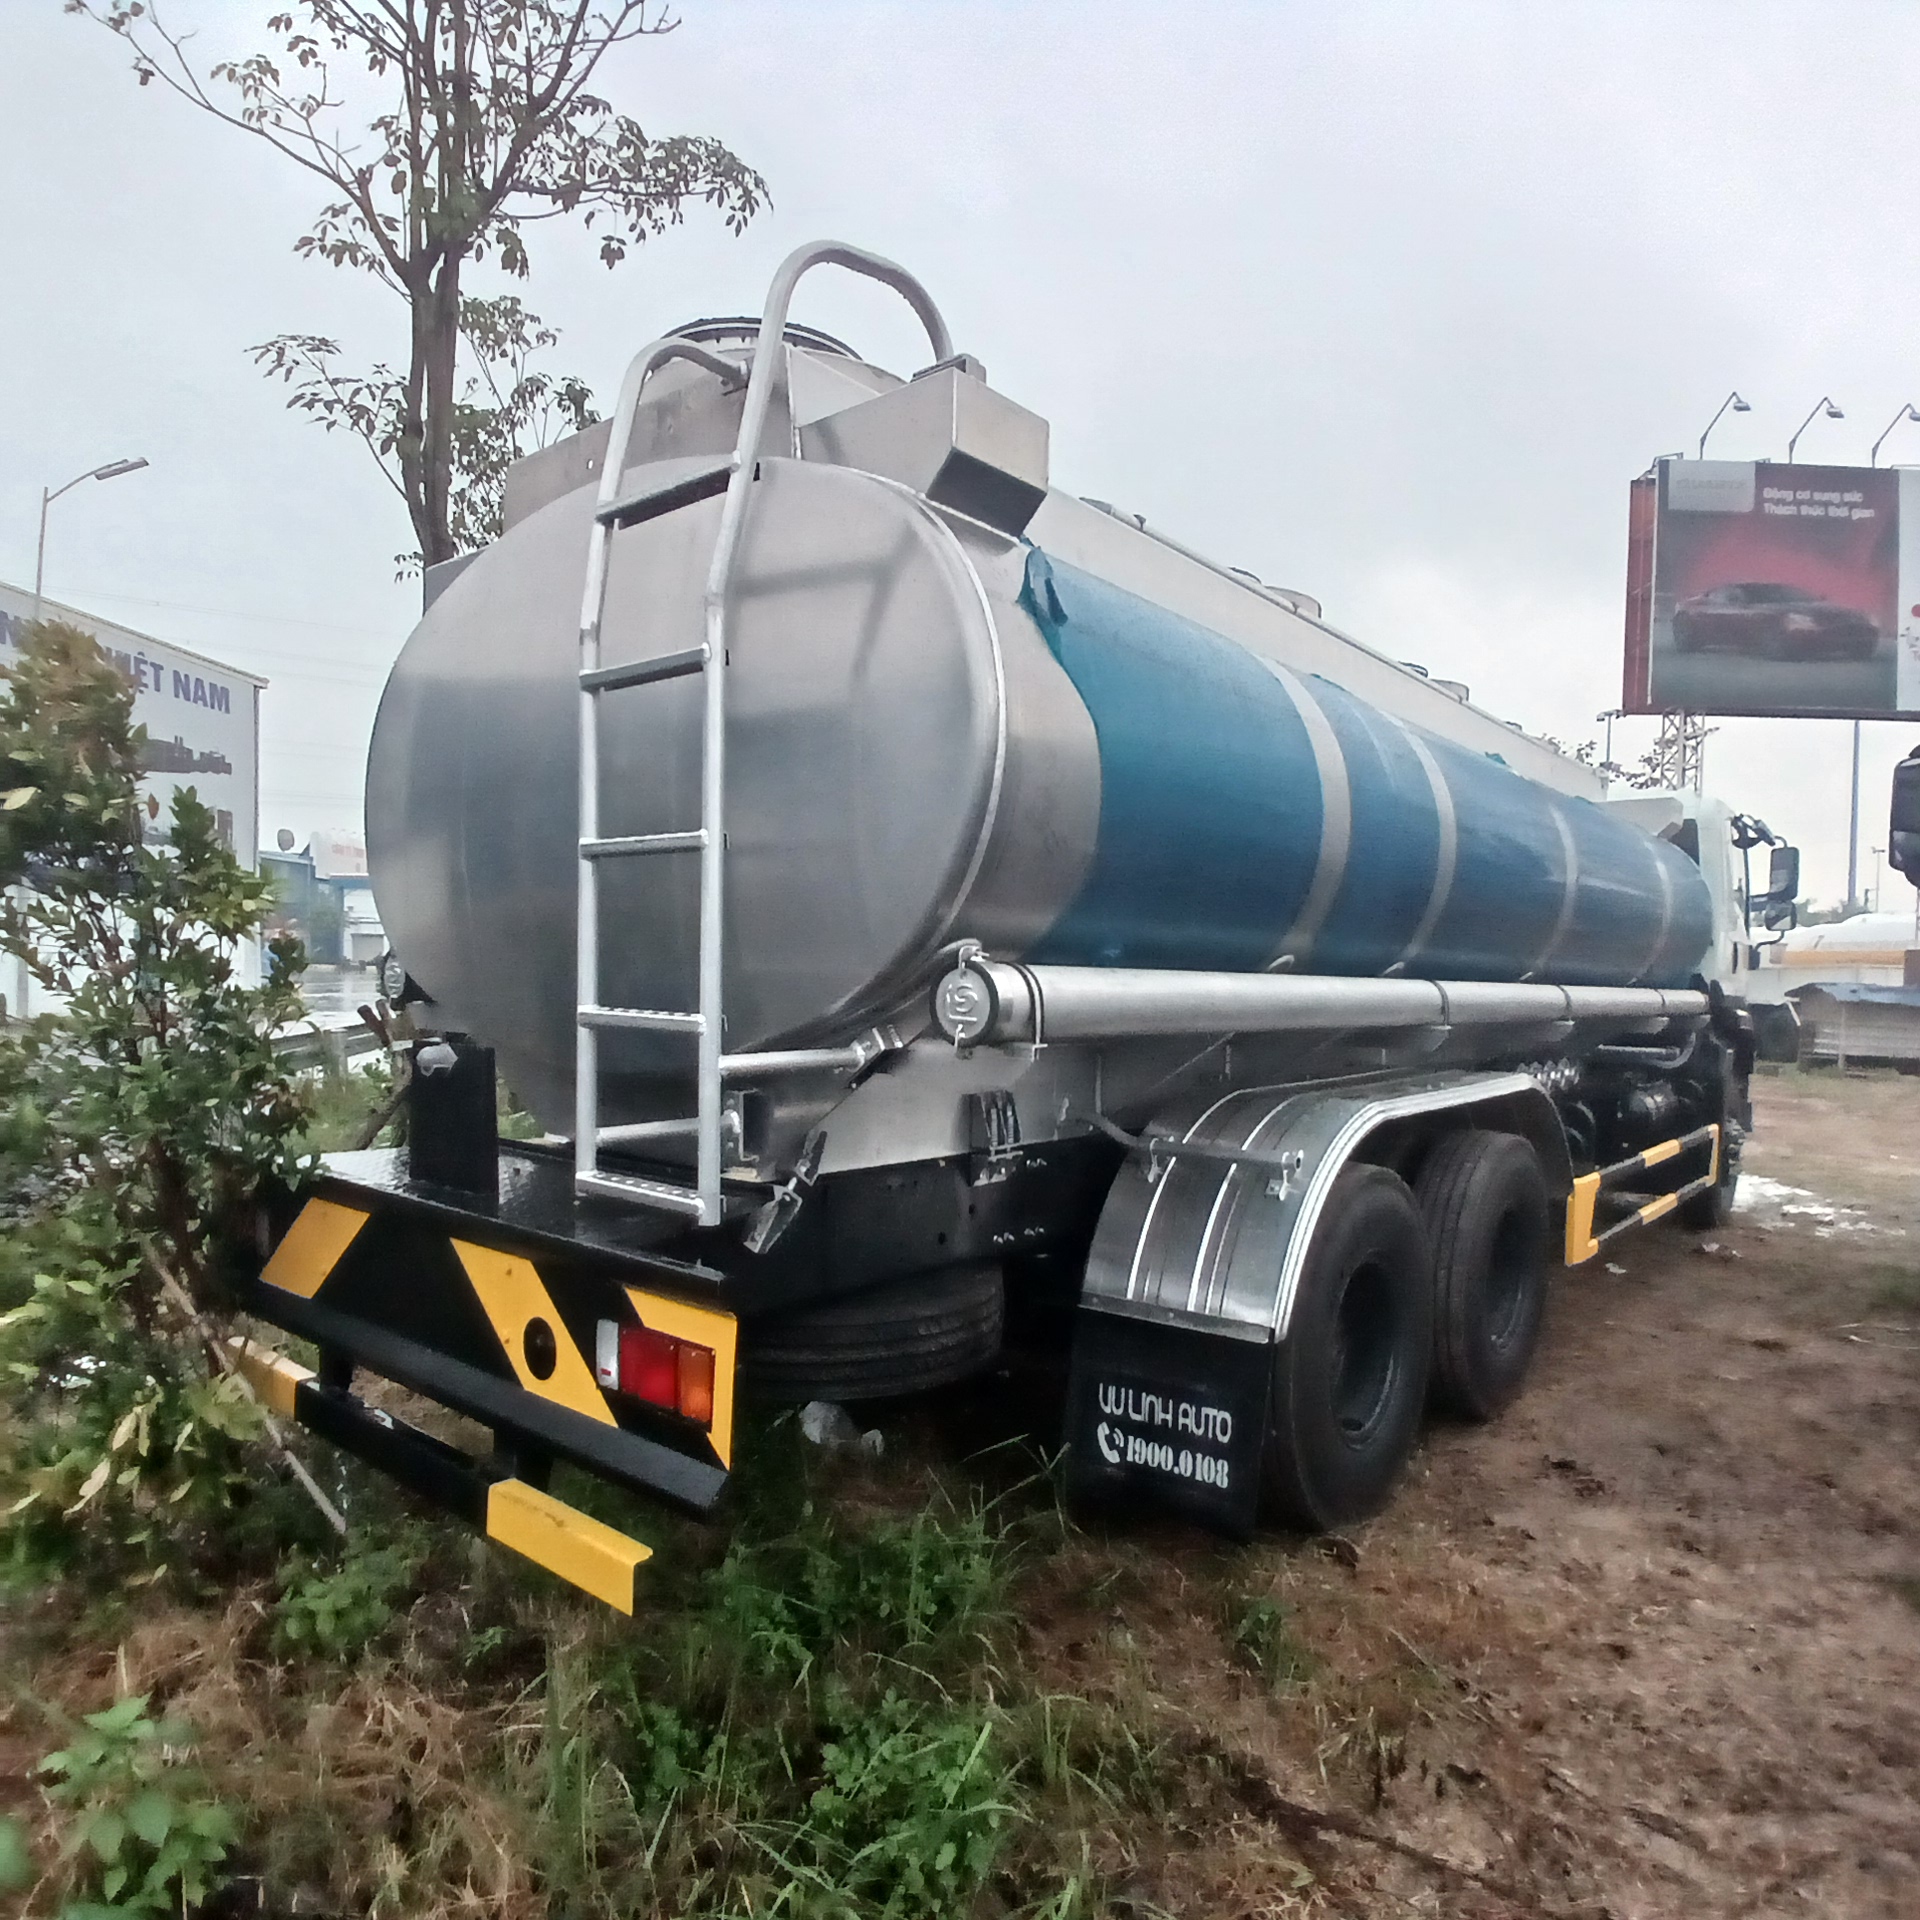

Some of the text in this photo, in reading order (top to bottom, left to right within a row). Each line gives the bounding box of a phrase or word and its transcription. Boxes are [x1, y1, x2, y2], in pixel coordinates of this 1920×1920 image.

[172, 669, 231, 715] NAM
[1128, 1389, 1172, 1428] LINH
[1177, 1402, 1232, 1444] AUTO
[1127, 1436, 1228, 1488] 1900.0108
